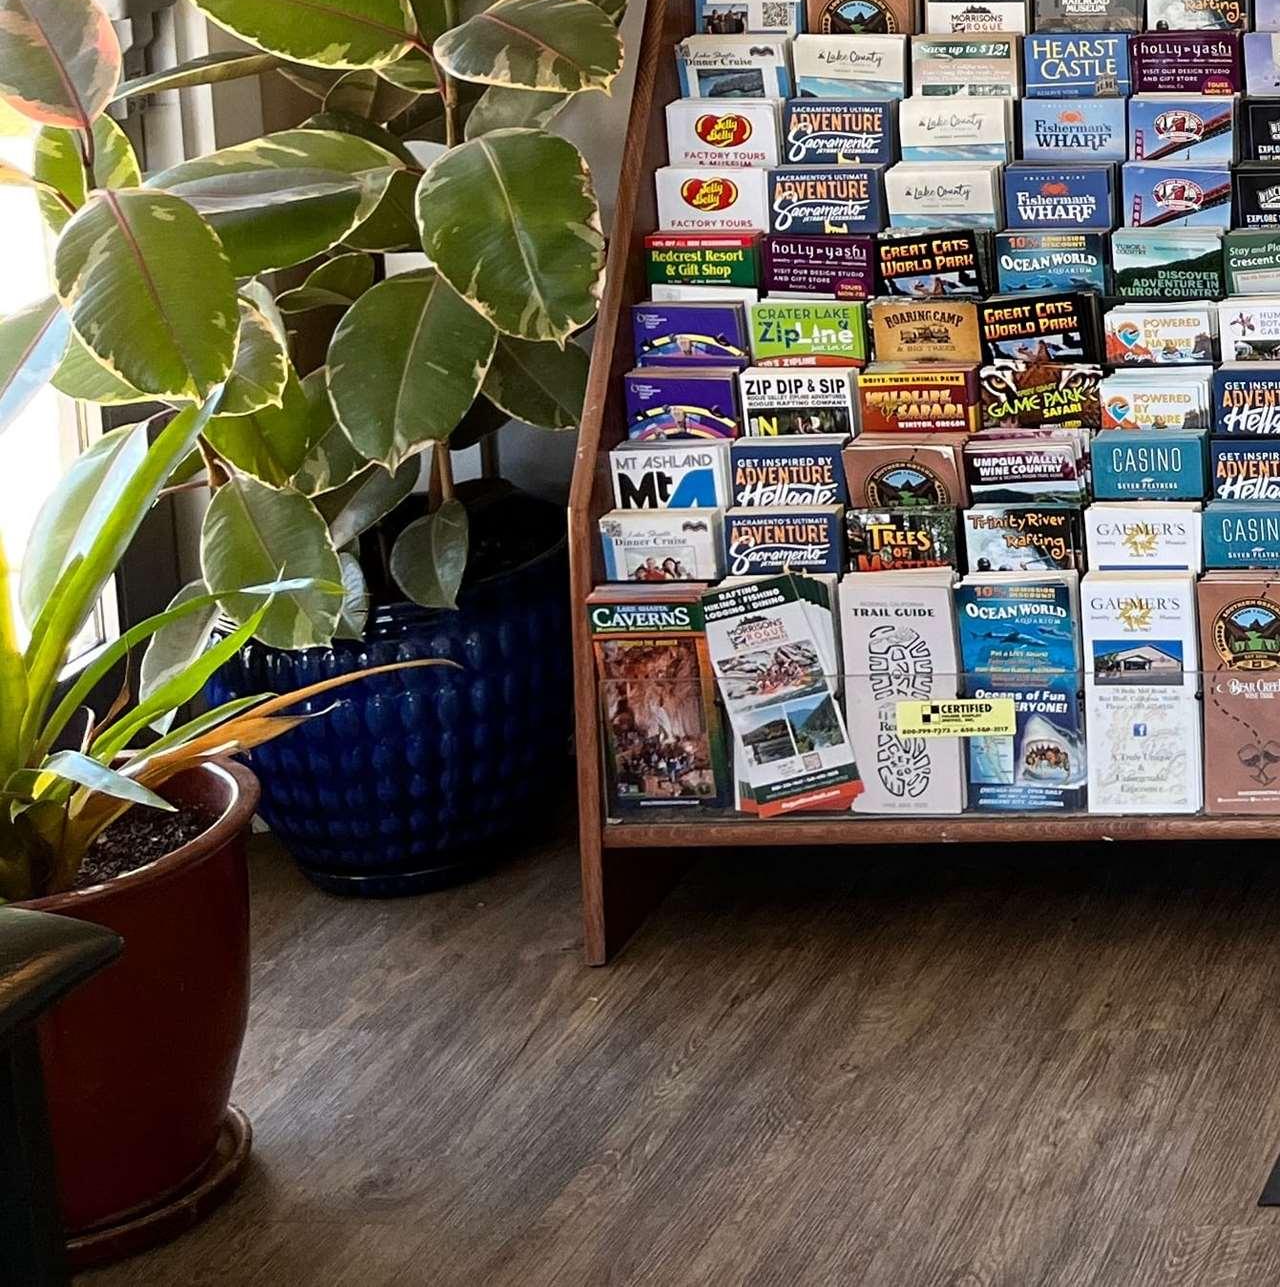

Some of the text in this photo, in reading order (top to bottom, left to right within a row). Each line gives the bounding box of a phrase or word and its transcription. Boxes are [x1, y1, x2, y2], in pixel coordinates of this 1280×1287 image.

[1065, 4, 1107, 12] MUSEUM
[919, 43, 1009, 57] Save up to $12!
[1033, 40, 1118, 59] HEARST
[1041, 59, 1118, 79] CASTLE
[714, 118, 738, 130] Jelly
[790, 113, 882, 131] ADVENTURE
[1034, 120, 1112, 133] Fisherman's
[707, 129, 735, 142] Belly
[788, 122, 884, 161] Sacramento
[1035, 133, 1112, 151] WHARF
[684, 151, 766, 160] FACTORY TOURS
[774, 180, 868, 199] ADVENTURE
[1016, 192, 1097, 205] Fisherman's
[1017, 205, 1097, 223] WHARF
[671, 219, 718, 227] FACTORY
[652, 250, 744, 261] Redcrest Resort
[880, 239, 969, 259] GREAT CATS
[1230, 247, 1249, 257] Stay
[1251, 245, 1266, 254] and
[880, 253, 974, 276] WORLD PARK
[1001, 252, 1097, 271] OCEAN WORLD
[1230, 256, 1274, 267] Crescent
[665, 264, 731, 277] & Gift Shop
[1158, 270, 1218, 280] DISCOVER
[1118, 287, 1220, 296] YUROK COUNTRY
[757, 309, 849, 319] CRATER LAKE
[883, 310, 964, 329] ROARING CAMP
[1143, 318, 1200, 328] POWERED
[758, 321, 853, 348] ZipLine
[1144, 329, 1158, 338] BY
[1145, 338, 1192, 348] NATURE
[745, 379, 845, 395] ZIP DIP & SIP
[1225, 382, 1246, 390] GET
[865, 389, 951, 407] WILDLIFE
[987, 387, 1089, 418] GAME PARK
[1133, 393, 1191, 403] POWERED
[897, 404, 964, 419] SAFARI
[1134, 413, 1182, 423] NATURE
[616, 454, 712, 469] MT ASHLAND
[973, 456, 1065, 467] UMPQUA VALLEY
[1112, 447, 1182, 472] CASINO
[979, 465, 1062, 476] WINE COUNTRY
[865, 523, 931, 552] TREES
[965, 603, 1067, 620] OCEAN WORLD
[941, 703, 992, 713] CERTIFIED
